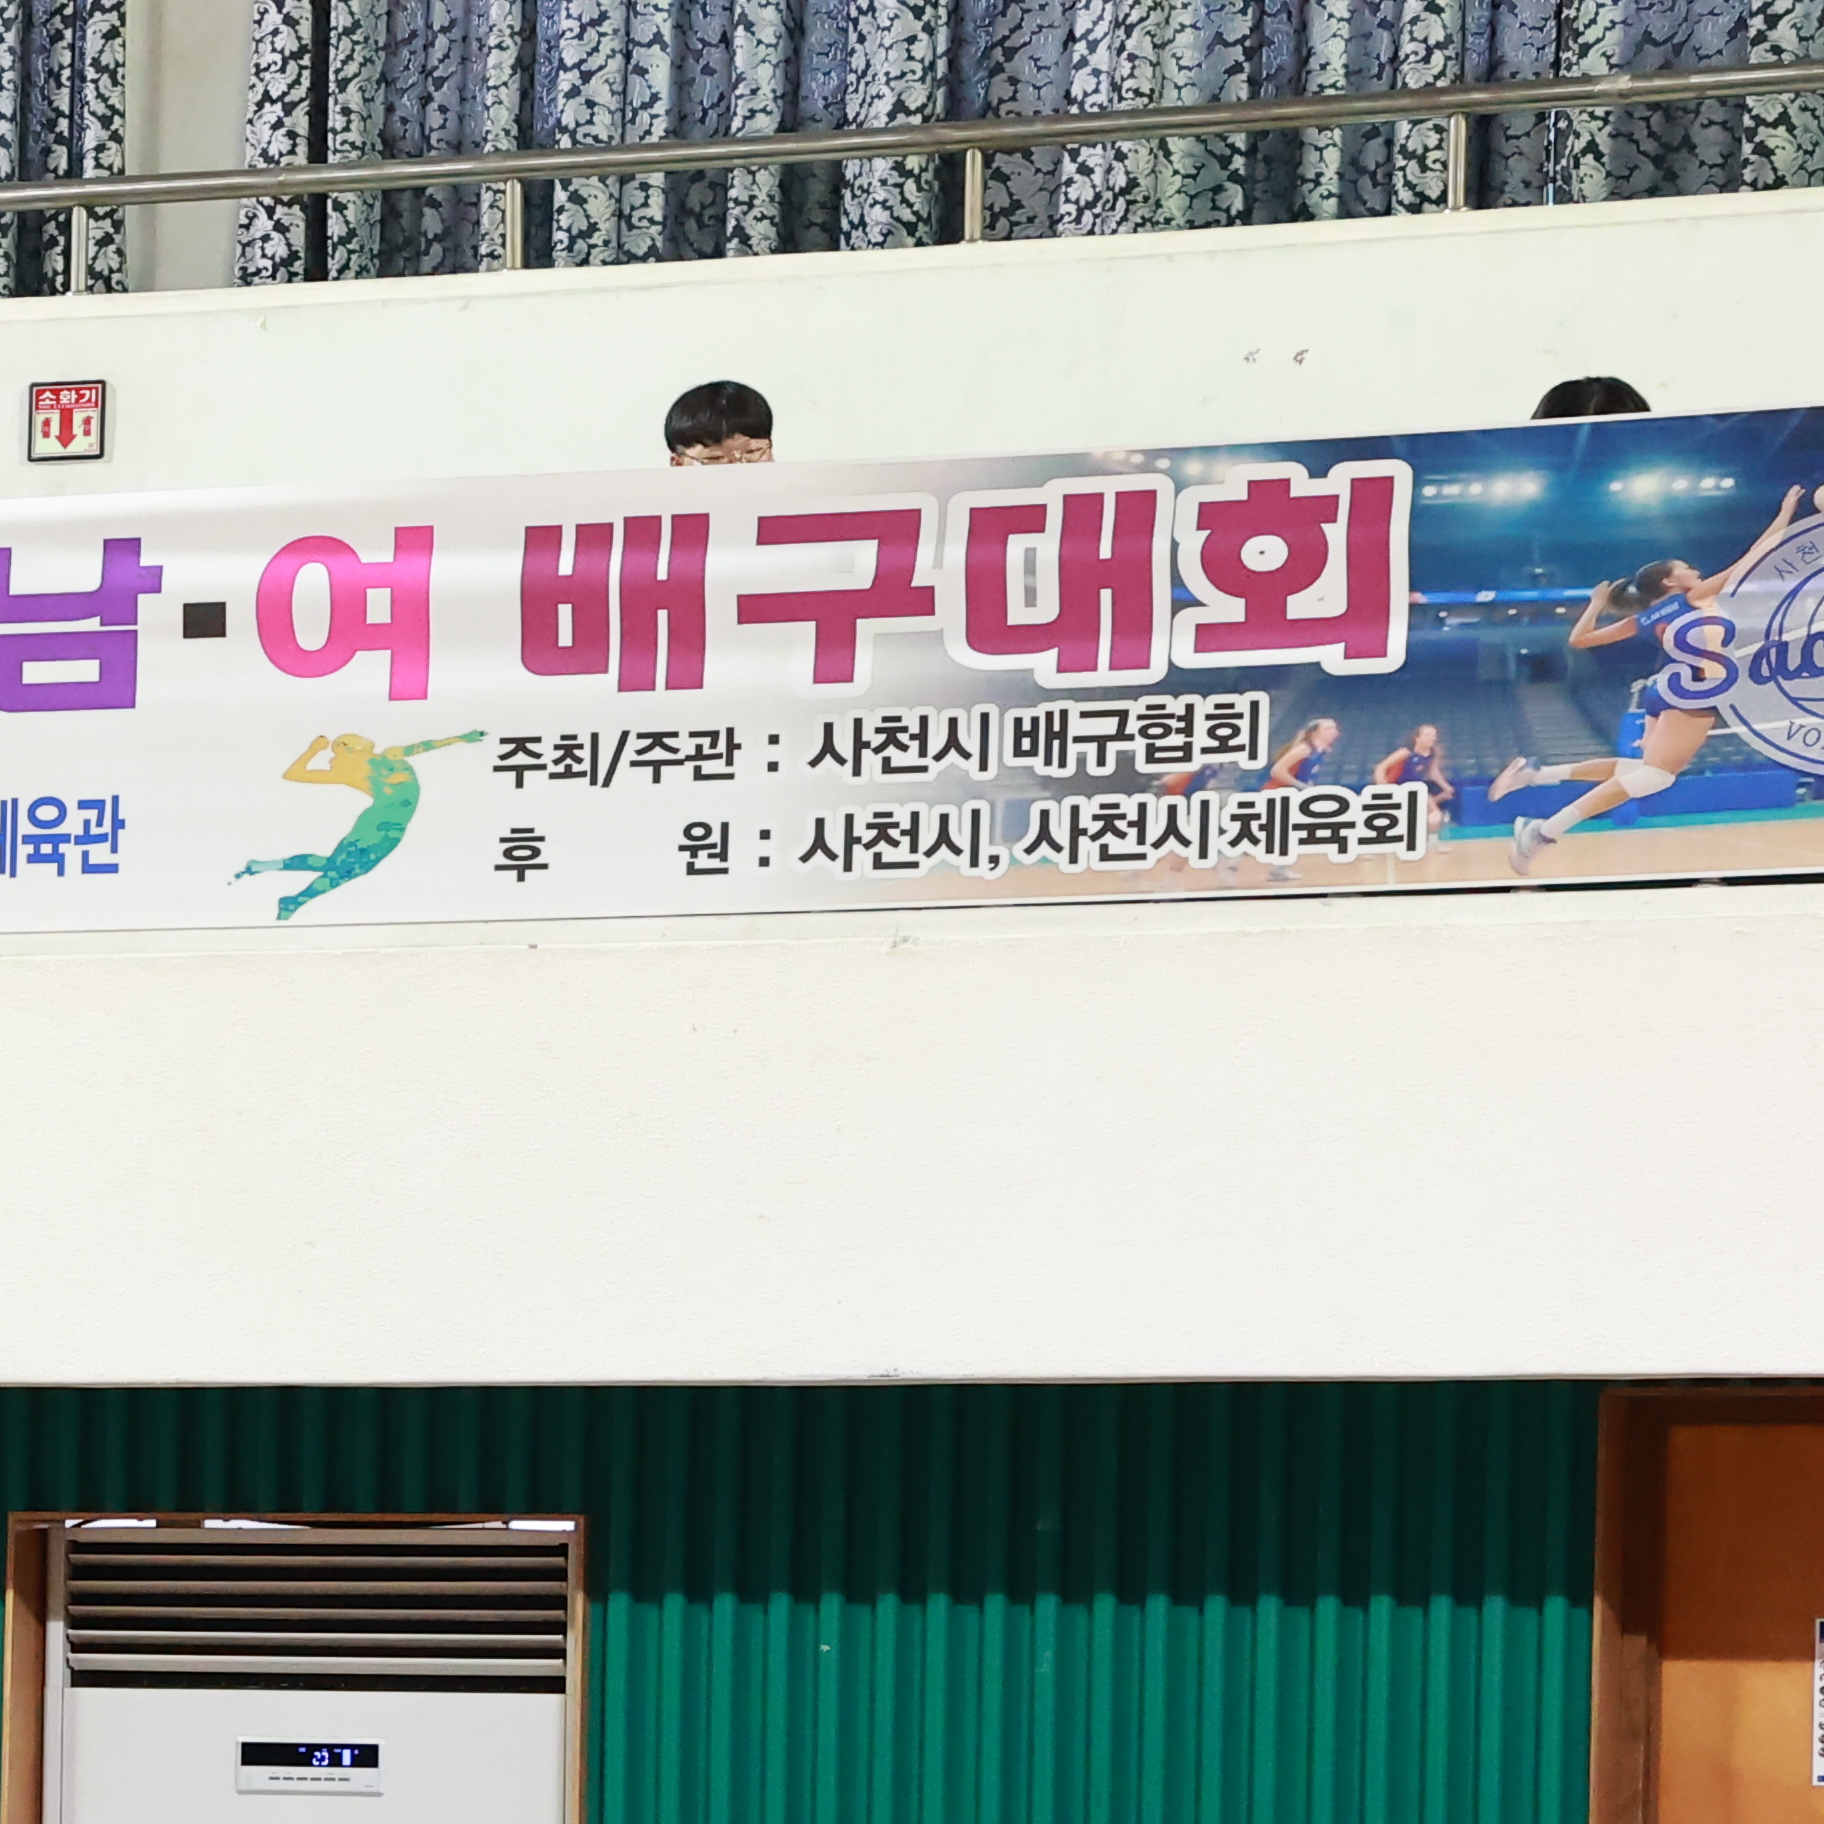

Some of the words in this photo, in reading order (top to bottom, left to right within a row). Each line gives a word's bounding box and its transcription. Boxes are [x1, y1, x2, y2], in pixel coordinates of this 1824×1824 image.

[38, 389, 96, 405] 소화기
[519, 475, 1395, 693] 배구대회
[492, 727, 742, 789] 주최/주관
[808, 711, 990, 777] 사천시
[1012, 699, 1261, 769] 배구협회
[1786, 720, 1824, 750] VO
[798, 808, 1001, 873] 사천시,
[1023, 798, 1211, 863] 사천시
[1228, 790, 1419, 858] 체육회
